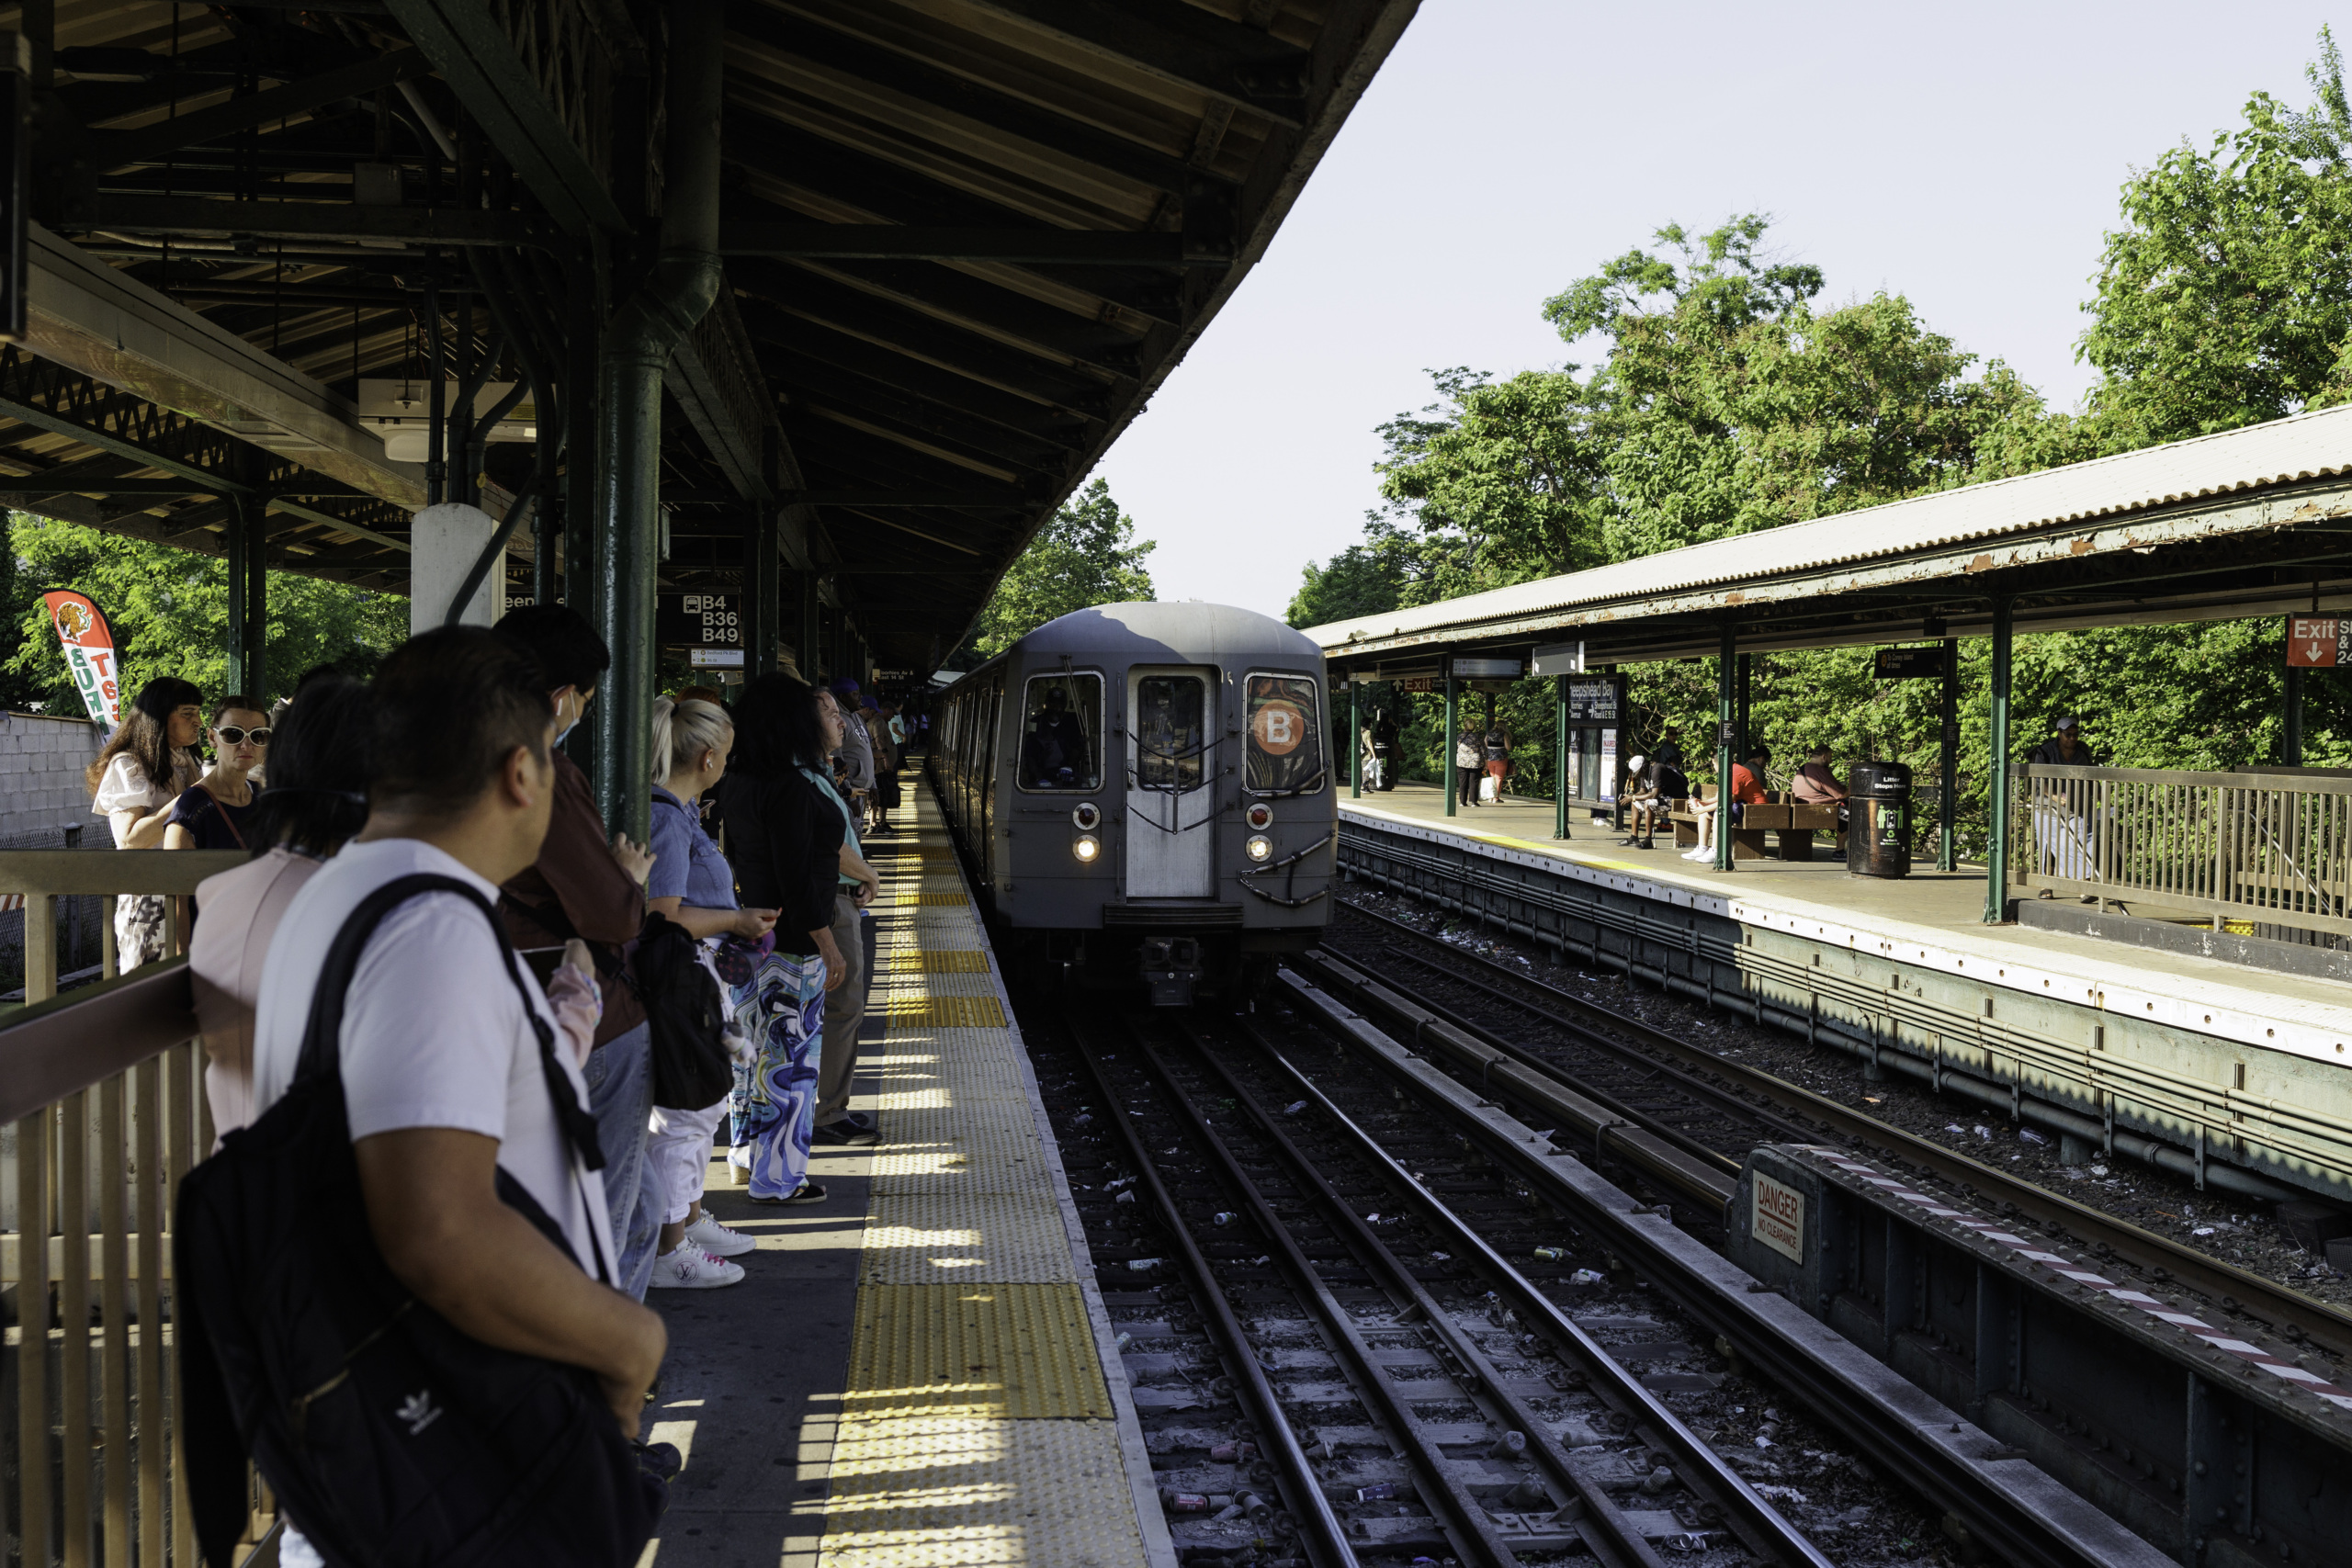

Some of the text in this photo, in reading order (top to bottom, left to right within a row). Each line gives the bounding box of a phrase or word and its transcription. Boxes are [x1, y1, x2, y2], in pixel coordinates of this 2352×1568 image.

[703, 595, 727, 610] B4
[703, 612, 738, 626] B36
[2294, 620, 2335, 638] Exit
[2339, 620, 2352, 634] S
[703, 628, 739, 642] B49
[2338, 636, 2349, 649] &
[1404, 678, 1430, 691] Exit
[1602, 680, 1614, 700] Bay
[1267, 711, 1291, 743] B
[1758, 1179, 1798, 1224] DANGER
[1758, 1217, 1797, 1249] NO CLEARANCE
